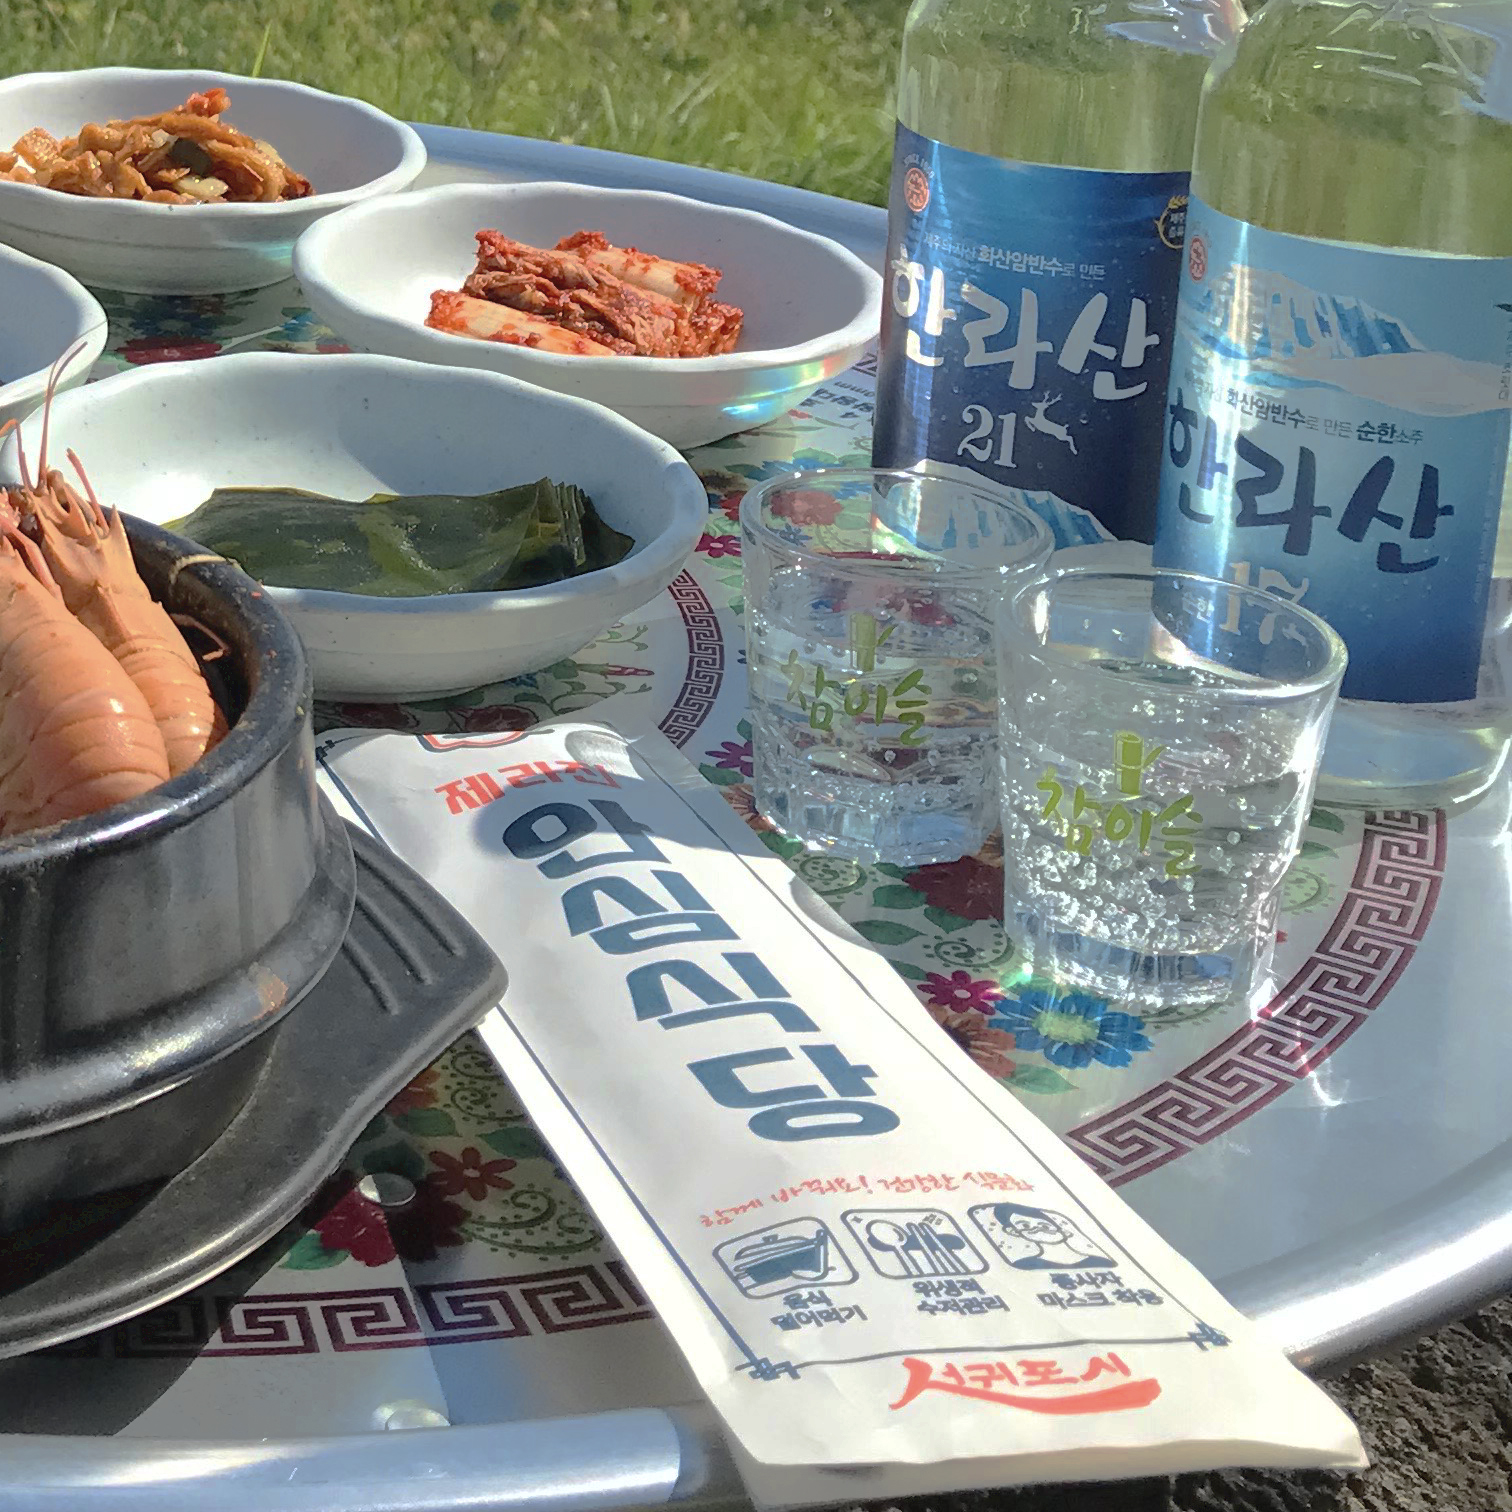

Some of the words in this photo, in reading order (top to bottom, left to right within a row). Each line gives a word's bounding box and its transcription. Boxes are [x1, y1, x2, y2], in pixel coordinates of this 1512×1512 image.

[977, 245, 1076, 278] 화산암반수로
[1079, 263, 1106, 280] 만든
[891, 243, 1160, 401] 한라산
[957, 404, 1018, 469] 21
[1324, 418, 1353, 439] 만든
[1169, 387, 1455, 573] 한라산
[1220, 561, 1311, 645] 17
[781, 648, 934, 747] 참이슬
[1036, 764, 1204, 877] 참이슬
[502, 798, 901, 1142] 안심식당
[912, 1278, 986, 1297] 위생적
[917, 1294, 1011, 1316] 수저관리
[1036, 1291, 1116, 1310] 마스크
[889, 1351, 1162, 1415] 서귀포시
